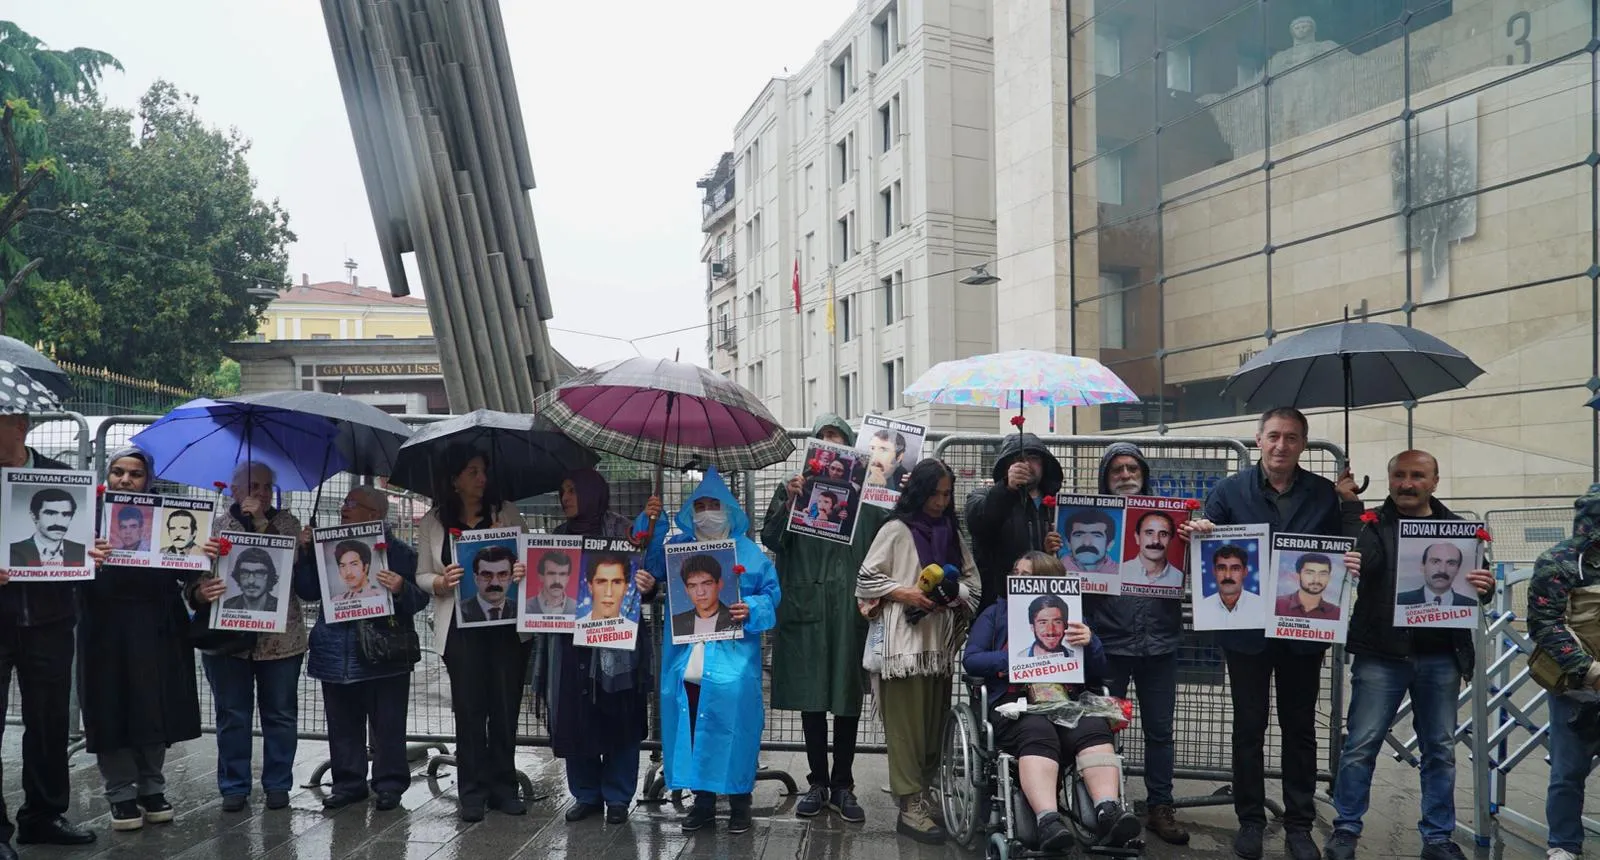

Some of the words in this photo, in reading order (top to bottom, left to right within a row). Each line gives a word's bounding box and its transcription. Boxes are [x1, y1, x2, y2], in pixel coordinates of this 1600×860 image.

[1507, 11, 1530, 65] 3
[323, 365, 403, 375] GALATASARAY
[11, 473, 62, 484] SÜLEYMAN
[63, 473, 91, 484] CİHAN
[114, 495, 132, 504] EDİP
[133, 496, 154, 505] ÇELİK
[864, 492, 902, 503] AYBEDİL
[1059, 495, 1094, 506] İBRAHİM
[1096, 497, 1124, 507] DEMİR
[1128, 498, 1156, 508] ENAN
[165, 499, 191, 508] BRAHİM
[192, 501, 211, 510] ÇELİK
[316, 527, 350, 541] MURAT
[351, 525, 382, 537] YILDIZ
[1402, 524, 1437, 535] RIDVAN
[483, 531, 518, 540] BULDAN
[270, 538, 294, 547] EREN
[527, 537, 554, 547] FEHMİ
[584, 538, 608, 550] EDİP
[610, 540, 641, 552] AKSO
[667, 544, 698, 554] ORHAN
[700, 541, 734, 551] CİNGÖZ
[1276, 537, 1318, 550] SERDAR
[8, 569, 48, 577] ÖZALTINDA
[50, 569, 91, 577] KAYBEDİLDİ
[1011, 578, 1047, 594] HASAN
[1050, 579, 1079, 594] OCAK
[1081, 582, 1108, 592] EDİLDİ
[335, 604, 385, 619] KAYBEDİLDİ
[1407, 608, 1472, 625] KAYBEDİLDİ
[221, 619, 276, 630] KAYBEDİLDİ
[586, 630, 633, 645] KAYBEDİLDİ
[1276, 627, 1335, 640] KAYBEDİLDİ
[1012, 660, 1051, 671] GÖZALTINDA
[1013, 660, 1079, 680] KAYBEDİLDİ
